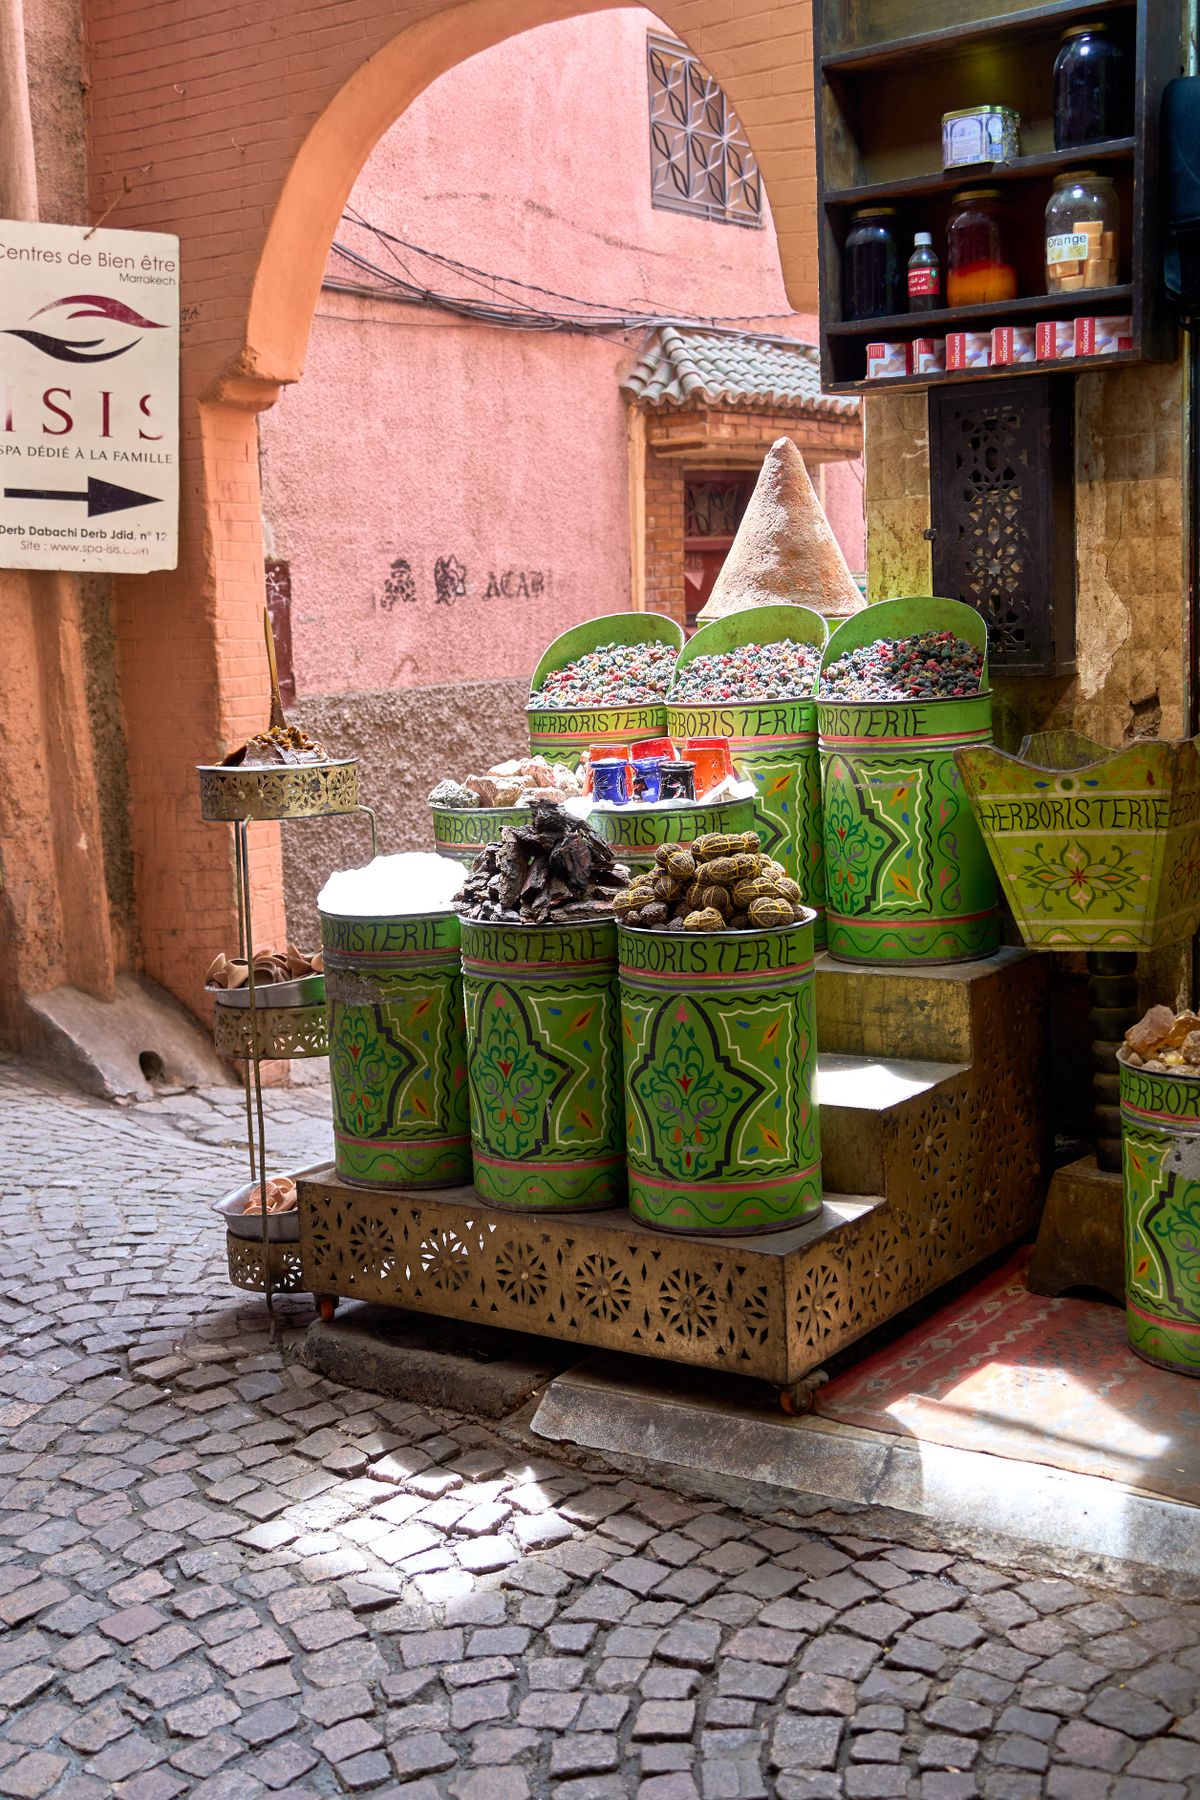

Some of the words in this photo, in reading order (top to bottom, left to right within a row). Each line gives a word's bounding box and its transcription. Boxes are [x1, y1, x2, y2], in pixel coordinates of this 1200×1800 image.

[1048, 235, 1087, 248] Orange
[68, 251, 92, 267] de
[98, 252, 135, 270] Bien
[141, 255, 176, 273] être
[119, 273, 176, 286] Marrakech
[3, 385, 164, 441] ISIS
[27, 444, 70, 459] DÉDIÉ
[75, 446, 85, 460] À
[90, 449, 108, 461] LA
[113, 450, 173, 465] FAMILLE
[0, 524, 26, 536] Derb
[29, 526, 77, 538] Dabachi
[80, 527, 107, 539] Derb
[20, 540, 41, 551] Site
[533, 707, 665, 733] HERBORISTERIE
[979, 798, 1169, 830] HERBORISTERIE
